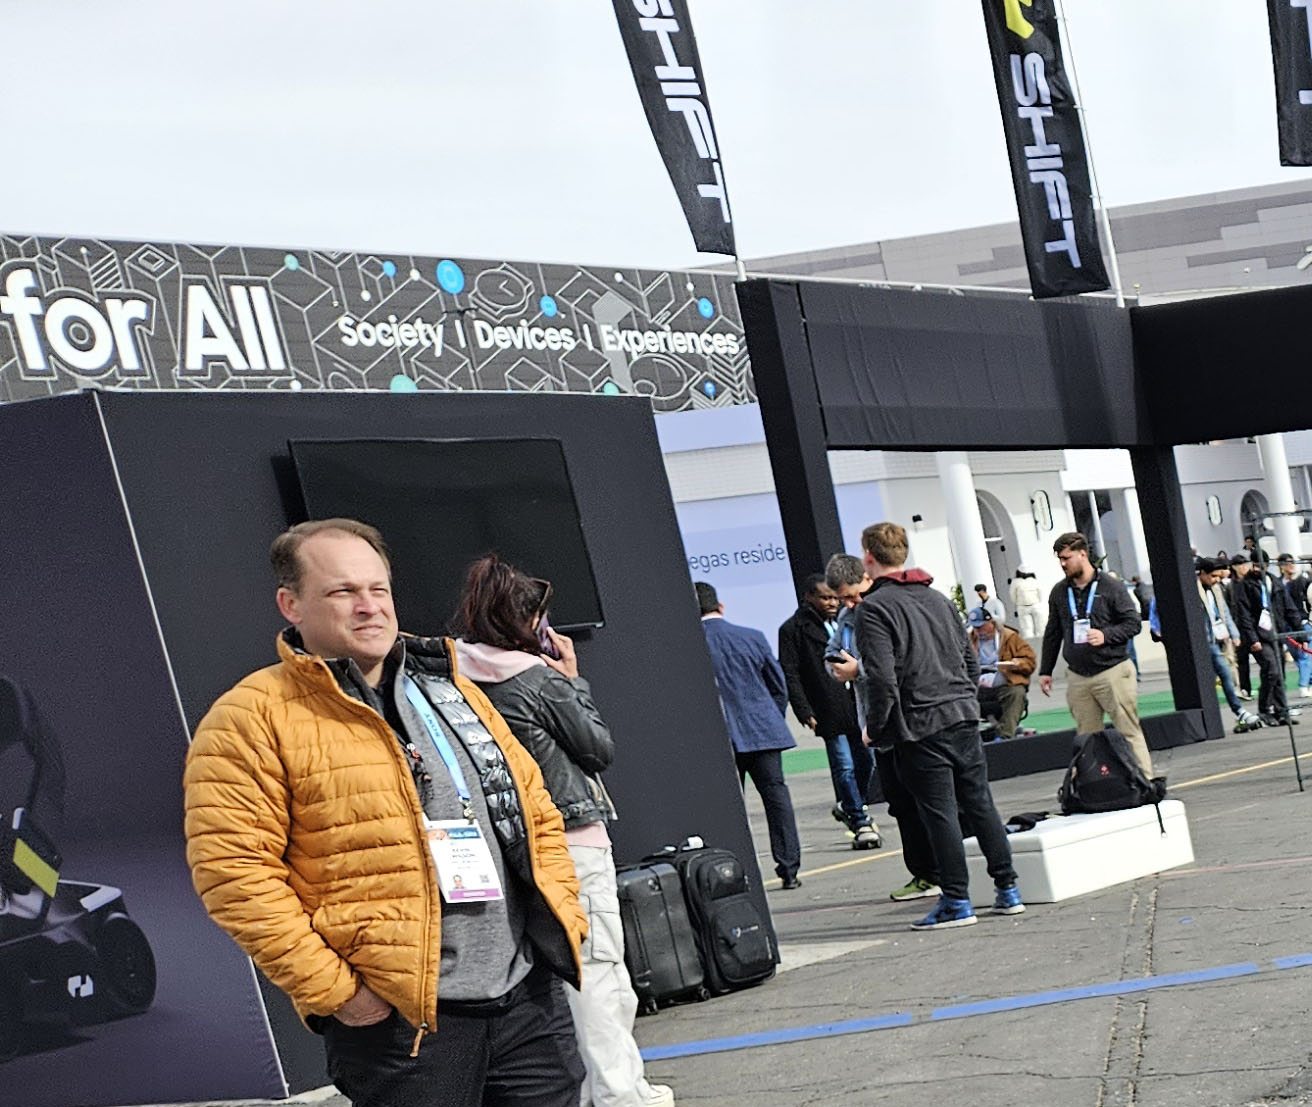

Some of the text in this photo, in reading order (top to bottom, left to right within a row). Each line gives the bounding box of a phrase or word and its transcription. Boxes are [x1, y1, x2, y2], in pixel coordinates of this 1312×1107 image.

[632, 0, 732, 224] HIFT
[1010, 52, 1082, 268] SHIFT
[0, 268, 287, 370] for All
[338, 315, 740, 363] Society Devices Experiences
[733, 543, 786, 564] reside
